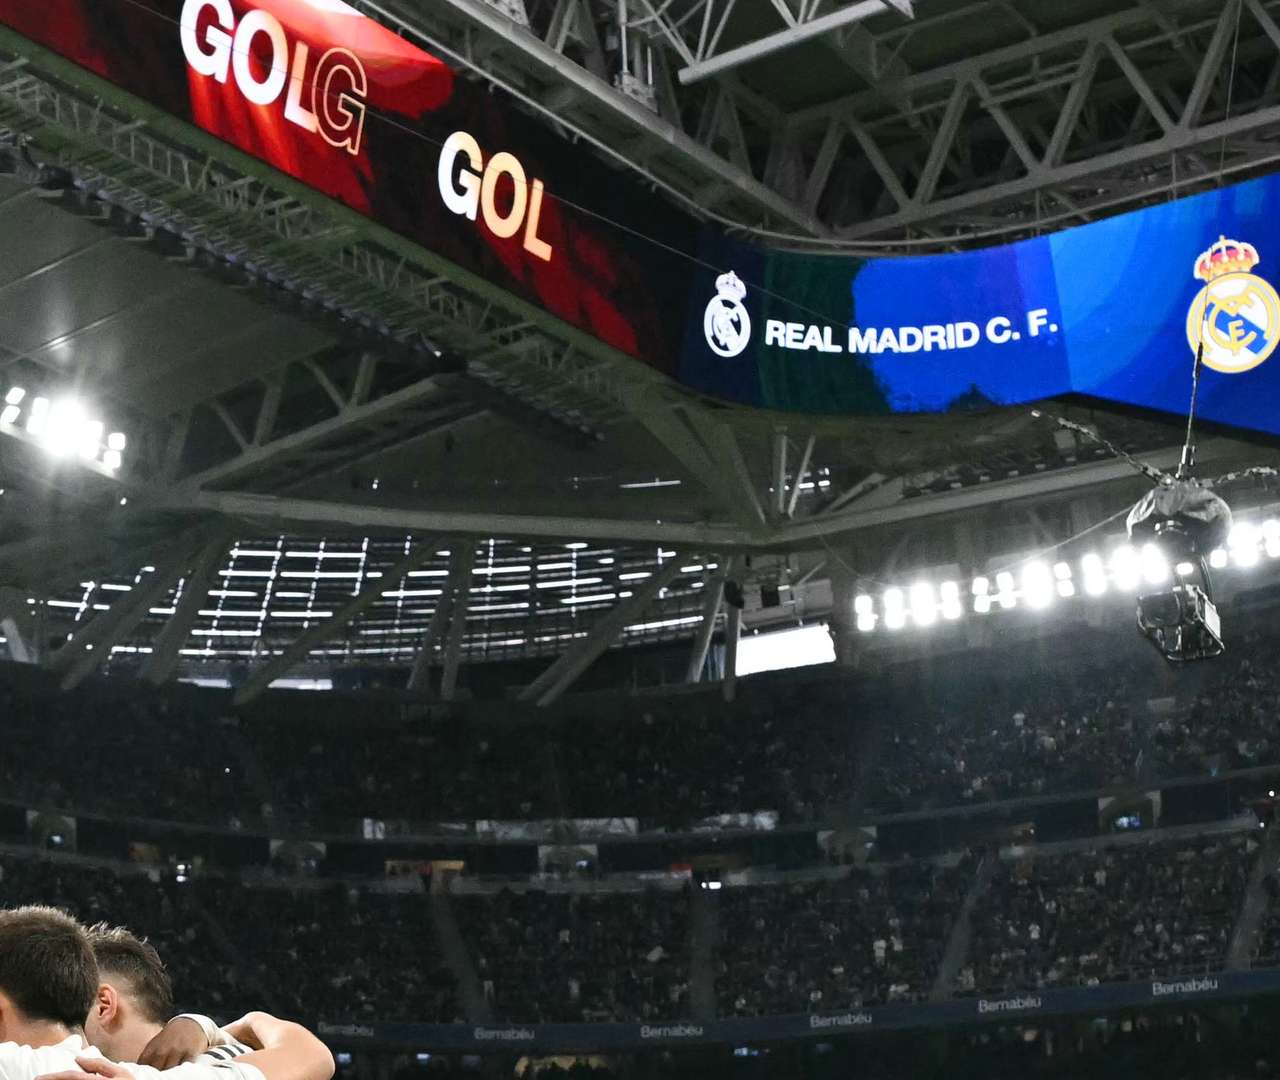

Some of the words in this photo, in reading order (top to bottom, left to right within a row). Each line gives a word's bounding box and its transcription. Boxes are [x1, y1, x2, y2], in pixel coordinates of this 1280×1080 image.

[437, 130, 553, 262] GOL
[765, 319, 843, 353] REAL
[848, 321, 981, 354] MADRID
[986, 316, 1021, 344] C.
[1027, 308, 1058, 337] F.
[1152, 977, 1219, 996] Bernabéu
[978, 996, 1042, 1014] Bernabéu
[810, 1012, 873, 1029] Bernabéu
[640, 1024, 704, 1039] Bernabéu
